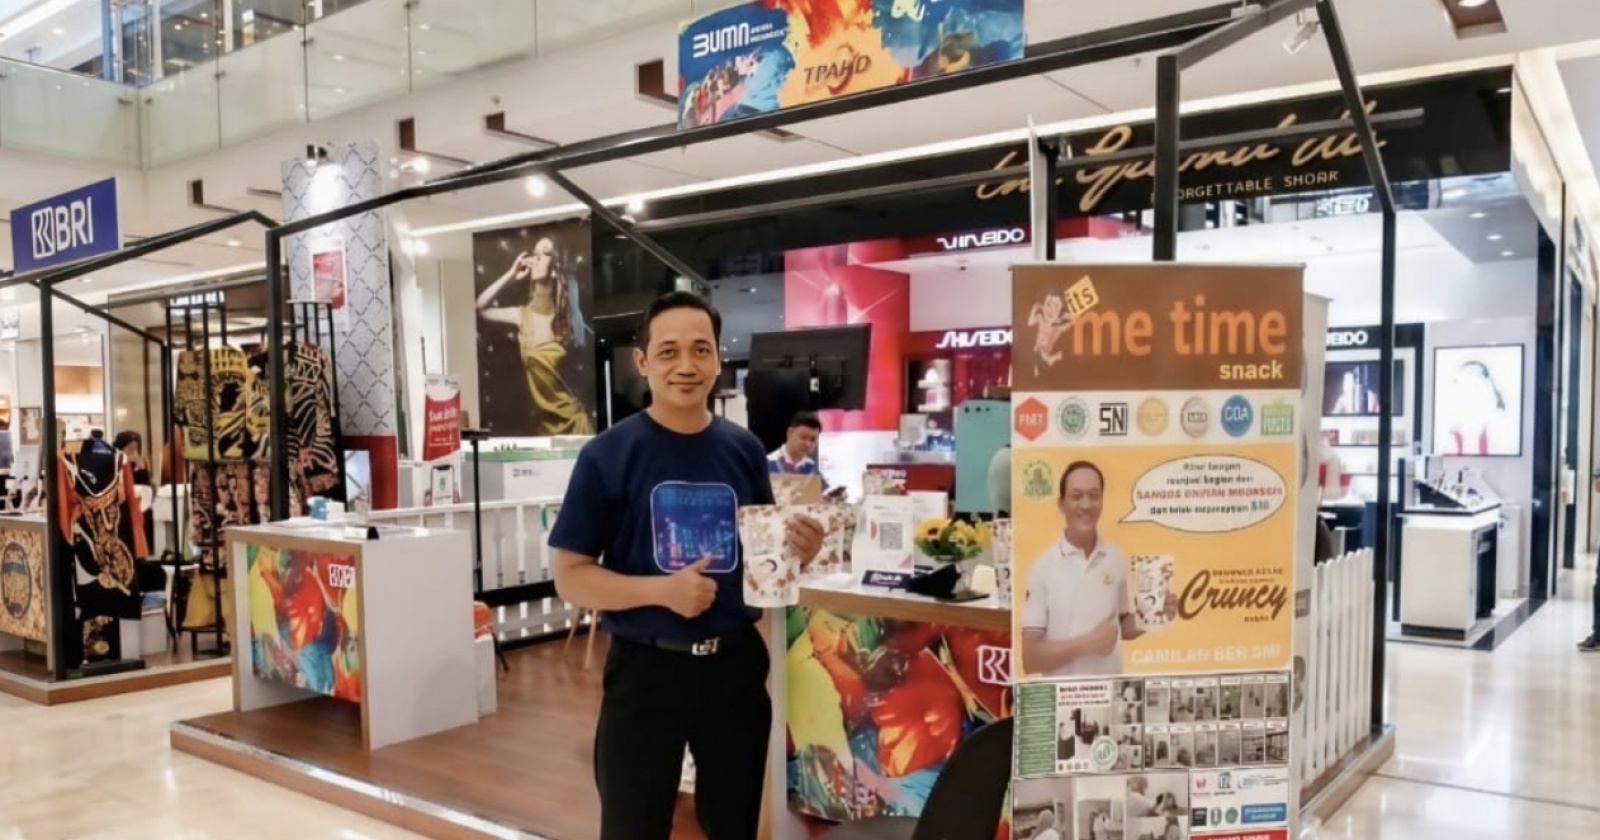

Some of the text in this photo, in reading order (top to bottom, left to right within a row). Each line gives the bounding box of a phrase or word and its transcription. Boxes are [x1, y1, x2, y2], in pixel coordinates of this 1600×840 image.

[55, 196, 94, 252] BRI
[1065, 288, 1095, 313] its
[1073, 294, 1286, 355] me time
[1220, 360, 1283, 380] snack
[1178, 569, 1288, 621] Cruncy
